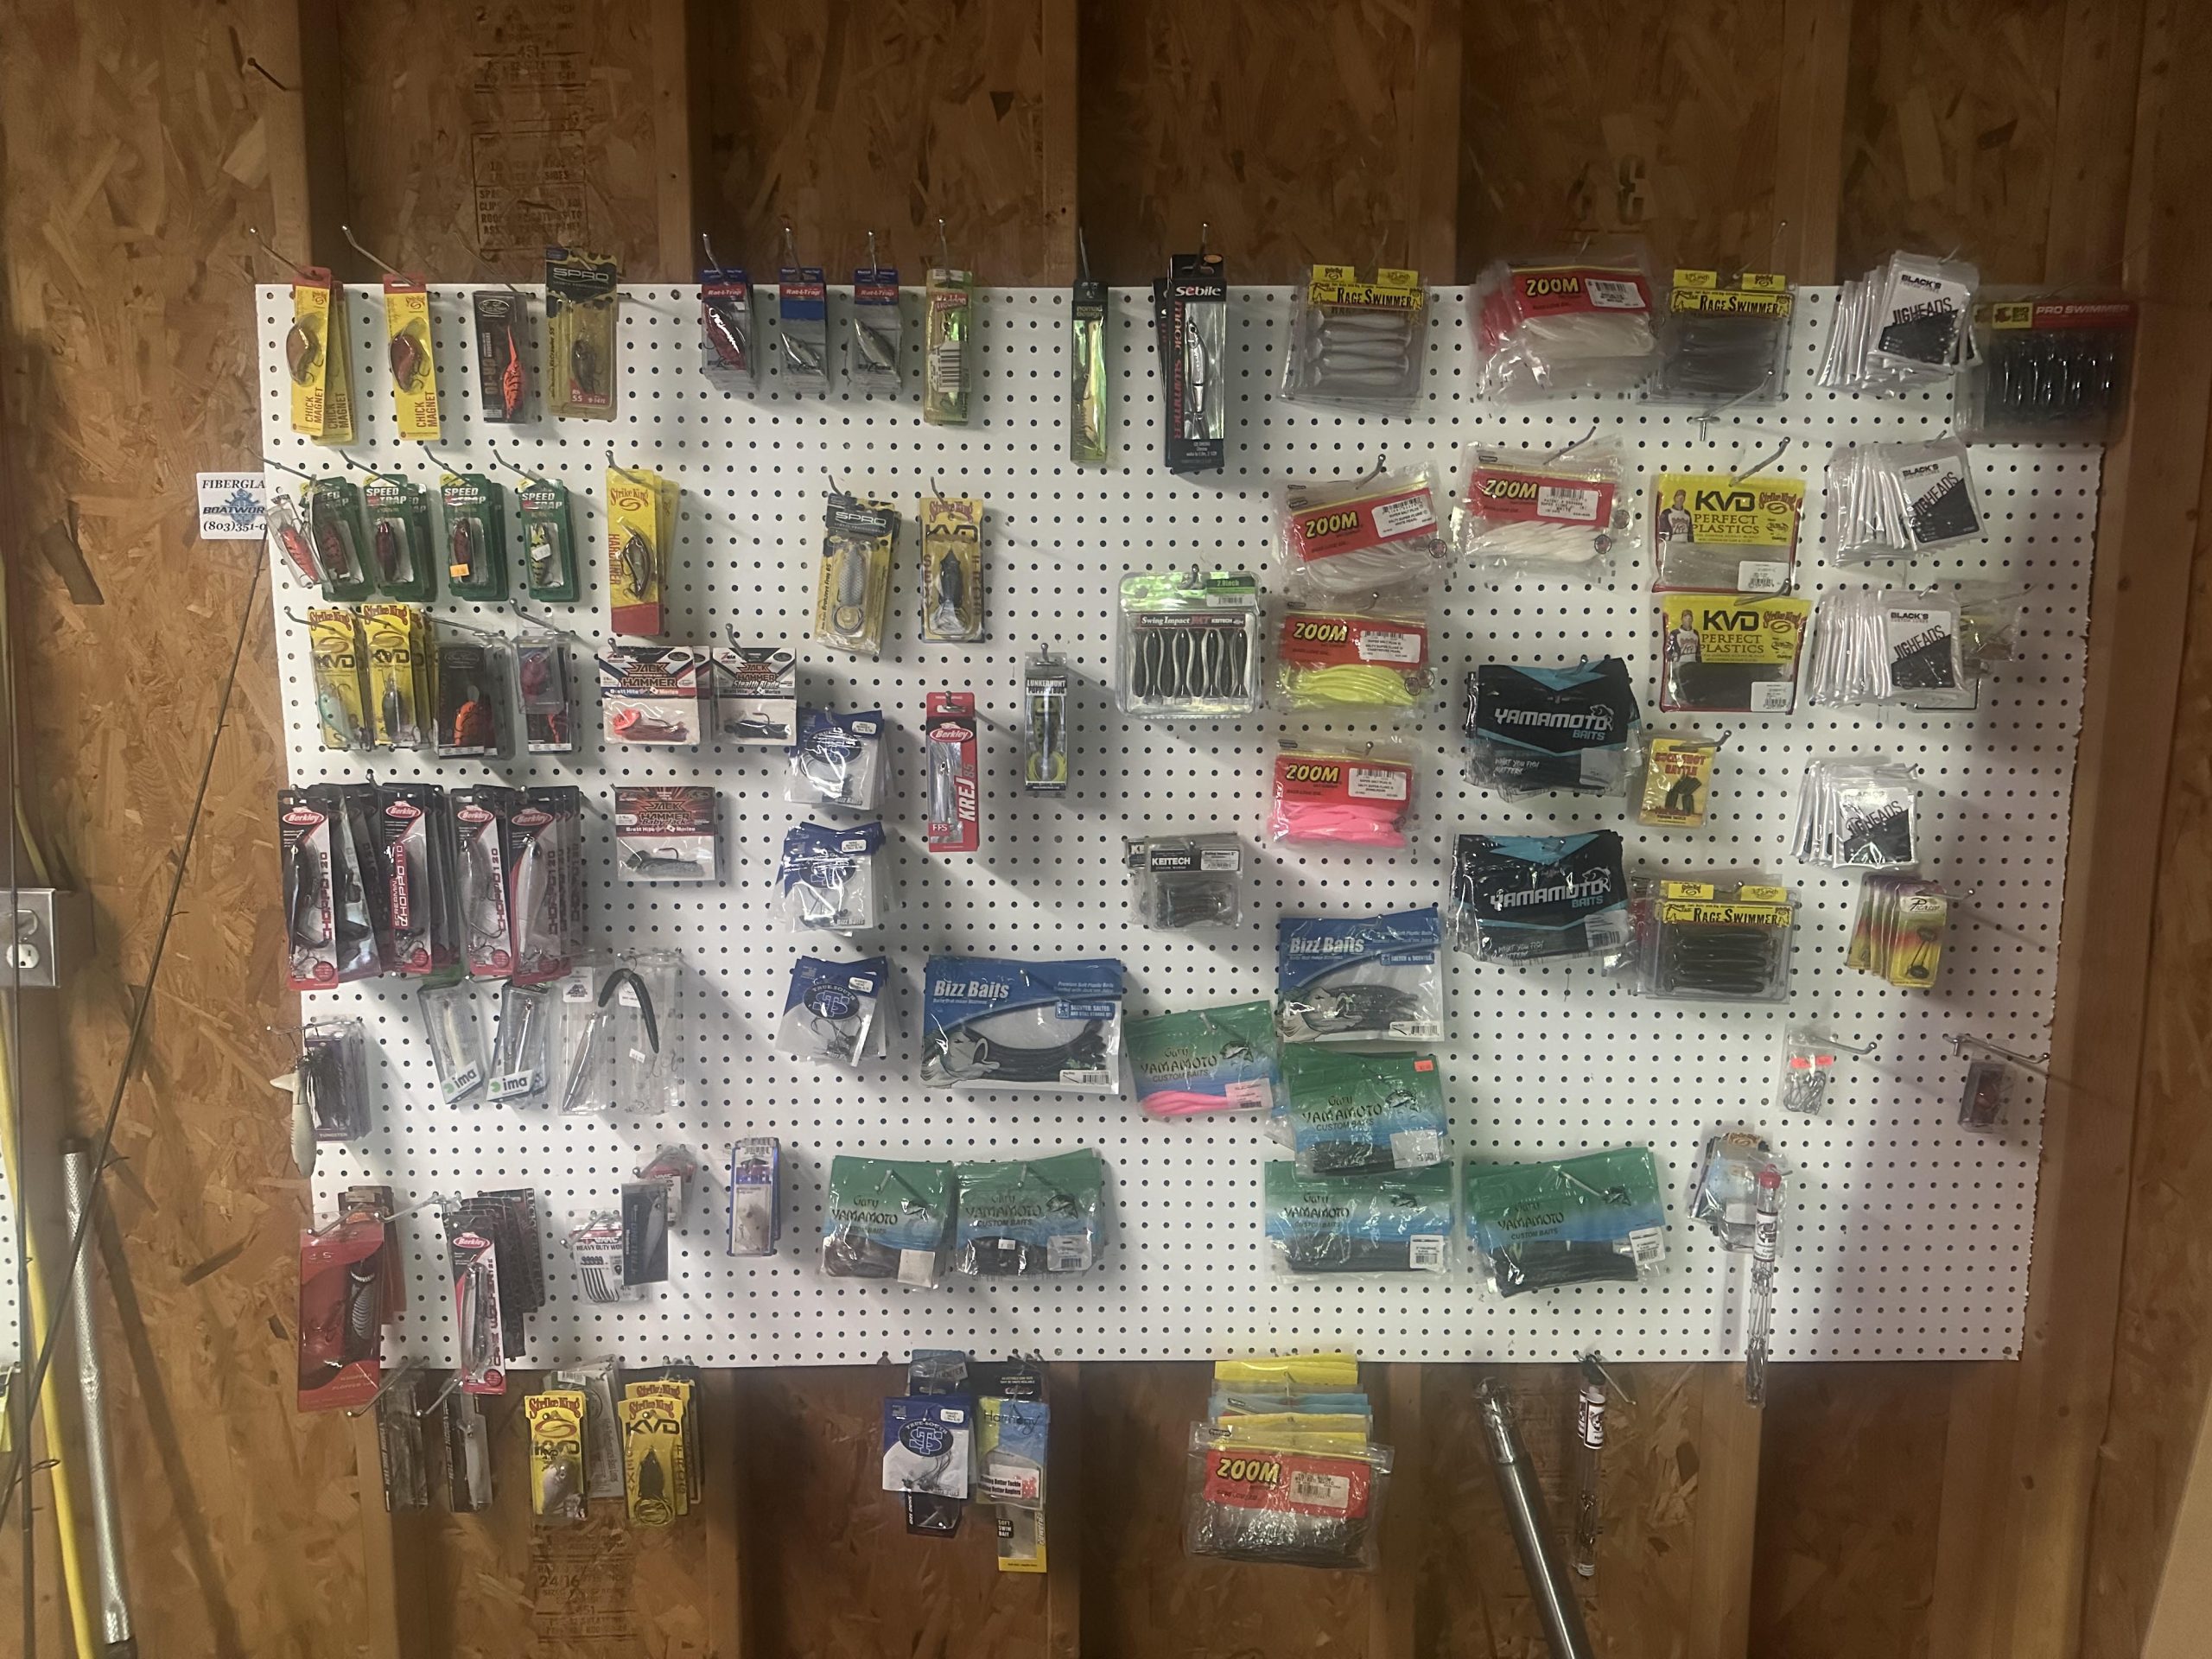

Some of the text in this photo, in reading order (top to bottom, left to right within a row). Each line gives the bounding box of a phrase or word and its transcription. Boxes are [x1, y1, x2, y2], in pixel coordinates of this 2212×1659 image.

[553, 267, 609, 282] SPRO
[1901, 274, 1942, 289] BLACK'S
[1175, 286, 1221, 296] Sebile
[1526, 276, 1580, 296] ZOOM
[1338, 288, 1412, 308] RAGE SWIMMER
[1700, 295, 1777, 315] RAGE SWIMMER
[1891, 296, 1952, 325] JIGHEADS
[2036, 304, 2129, 315] PRO SWIMMER
[305, 396, 315, 423] CHICK
[315, 387, 324, 423] MAGNET
[336, 393, 349, 429] MAGNET
[425, 391, 437, 427] MAGNET
[415, 402, 426, 428] CHICK
[1902, 464, 1939, 477] BLACK'S
[366, 487, 399, 496] SPEED
[444, 487, 479, 497] SPEED
[521, 492, 556, 501] SPEED
[610, 488, 649, 506] Strike King
[1483, 479, 1538, 500] ZOOM
[379, 496, 407, 505] TRAP
[1695, 490, 1755, 512] KVD
[836, 511, 887, 526] SPRO
[1306, 512, 1359, 539] ZOOM
[1694, 514, 1758, 524] PERFECT
[1692, 524, 1760, 534] PLASTICS
[309, 612, 352, 632] Strike King
[364, 604, 409, 625] Strike King
[1141, 615, 1190, 626] Swing Impact
[1703, 610, 1759, 631] KVD
[1891, 612, 1929, 620] BLACK'S
[1293, 622, 1349, 643] ZOOM
[1701, 633, 1763, 644] PERFECT
[1700, 644, 1764, 654] PLASTICS
[1893, 625, 1945, 660] JIGHEADS
[632, 663, 664, 673] JACK
[622, 678, 675, 687] HAMMER
[1495, 709, 1608, 731] YAMAMOTO
[934, 729, 969, 741] Berkley
[1572, 729, 1605, 741] BAITS
[1286, 765, 1340, 783] ZOOM
[958, 763, 976, 821] KREJ 85
[288, 812, 320, 823] Berkley
[390, 807, 418, 817] Berkley
[461, 810, 490, 820] Berkley
[516, 815, 548, 824] Berkley
[932, 823, 948, 832] FFS
[491, 848, 499, 871] 120
[1152, 857, 1191, 866] KEITECH
[391, 880, 400, 926] SCREAMIN
[397, 864, 409, 927] CHOPPO
[1490, 880, 1608, 911] YAMAMOTO
[1572, 895, 1604, 907] BAITS
[1694, 907, 1778, 925] RAGE SWIMMER
[1289, 937, 1319, 954] Bizz
[1323, 938, 1365, 954] Baits
[834, 985, 855, 1001] SOUTH
[934, 980, 1009, 999] Bizz Baits
[1163, 1046, 1189, 1059] Gary
[1140, 1055, 1217, 1075] YAMAMOTO
[454, 1068, 477, 1090] ima
[503, 1076, 528, 1091] ima
[1152, 1070, 1209, 1083] CUSTOM BAITS
[1328, 1096, 1353, 1106] Gary
[1302, 1103, 1382, 1123] YAMAMOTO
[1316, 1122, 1349, 1131] CUSTOM
[854, 1195, 879, 1209] Gary
[991, 1194, 1016, 1205] Gary
[832, 1209, 898, 1225] YAMAMOTO
[965, 1205, 1041, 1217] YAMAMOTO
[1284, 1206, 1350, 1218] YAMAMOTO
[977, 1217, 1033, 1227] CUSTOM BAITS
[1497, 1211, 1564, 1230] YAMAMOTO
[457, 1236, 486, 1247] Berkley
[1511, 1228, 1558, 1240] CUSTOM BAITS
[637, 1384, 681, 1398] Strike King
[528, 1397, 581, 1419] Strike King
[628, 1401, 675, 1420] Strike King
[626, 1419, 681, 1435] KVD
[906, 1421, 948, 1434] TRUE SOUTH
[984, 1409, 1043, 1435] Harmony
[1217, 1458, 1282, 1483] ZOOM
